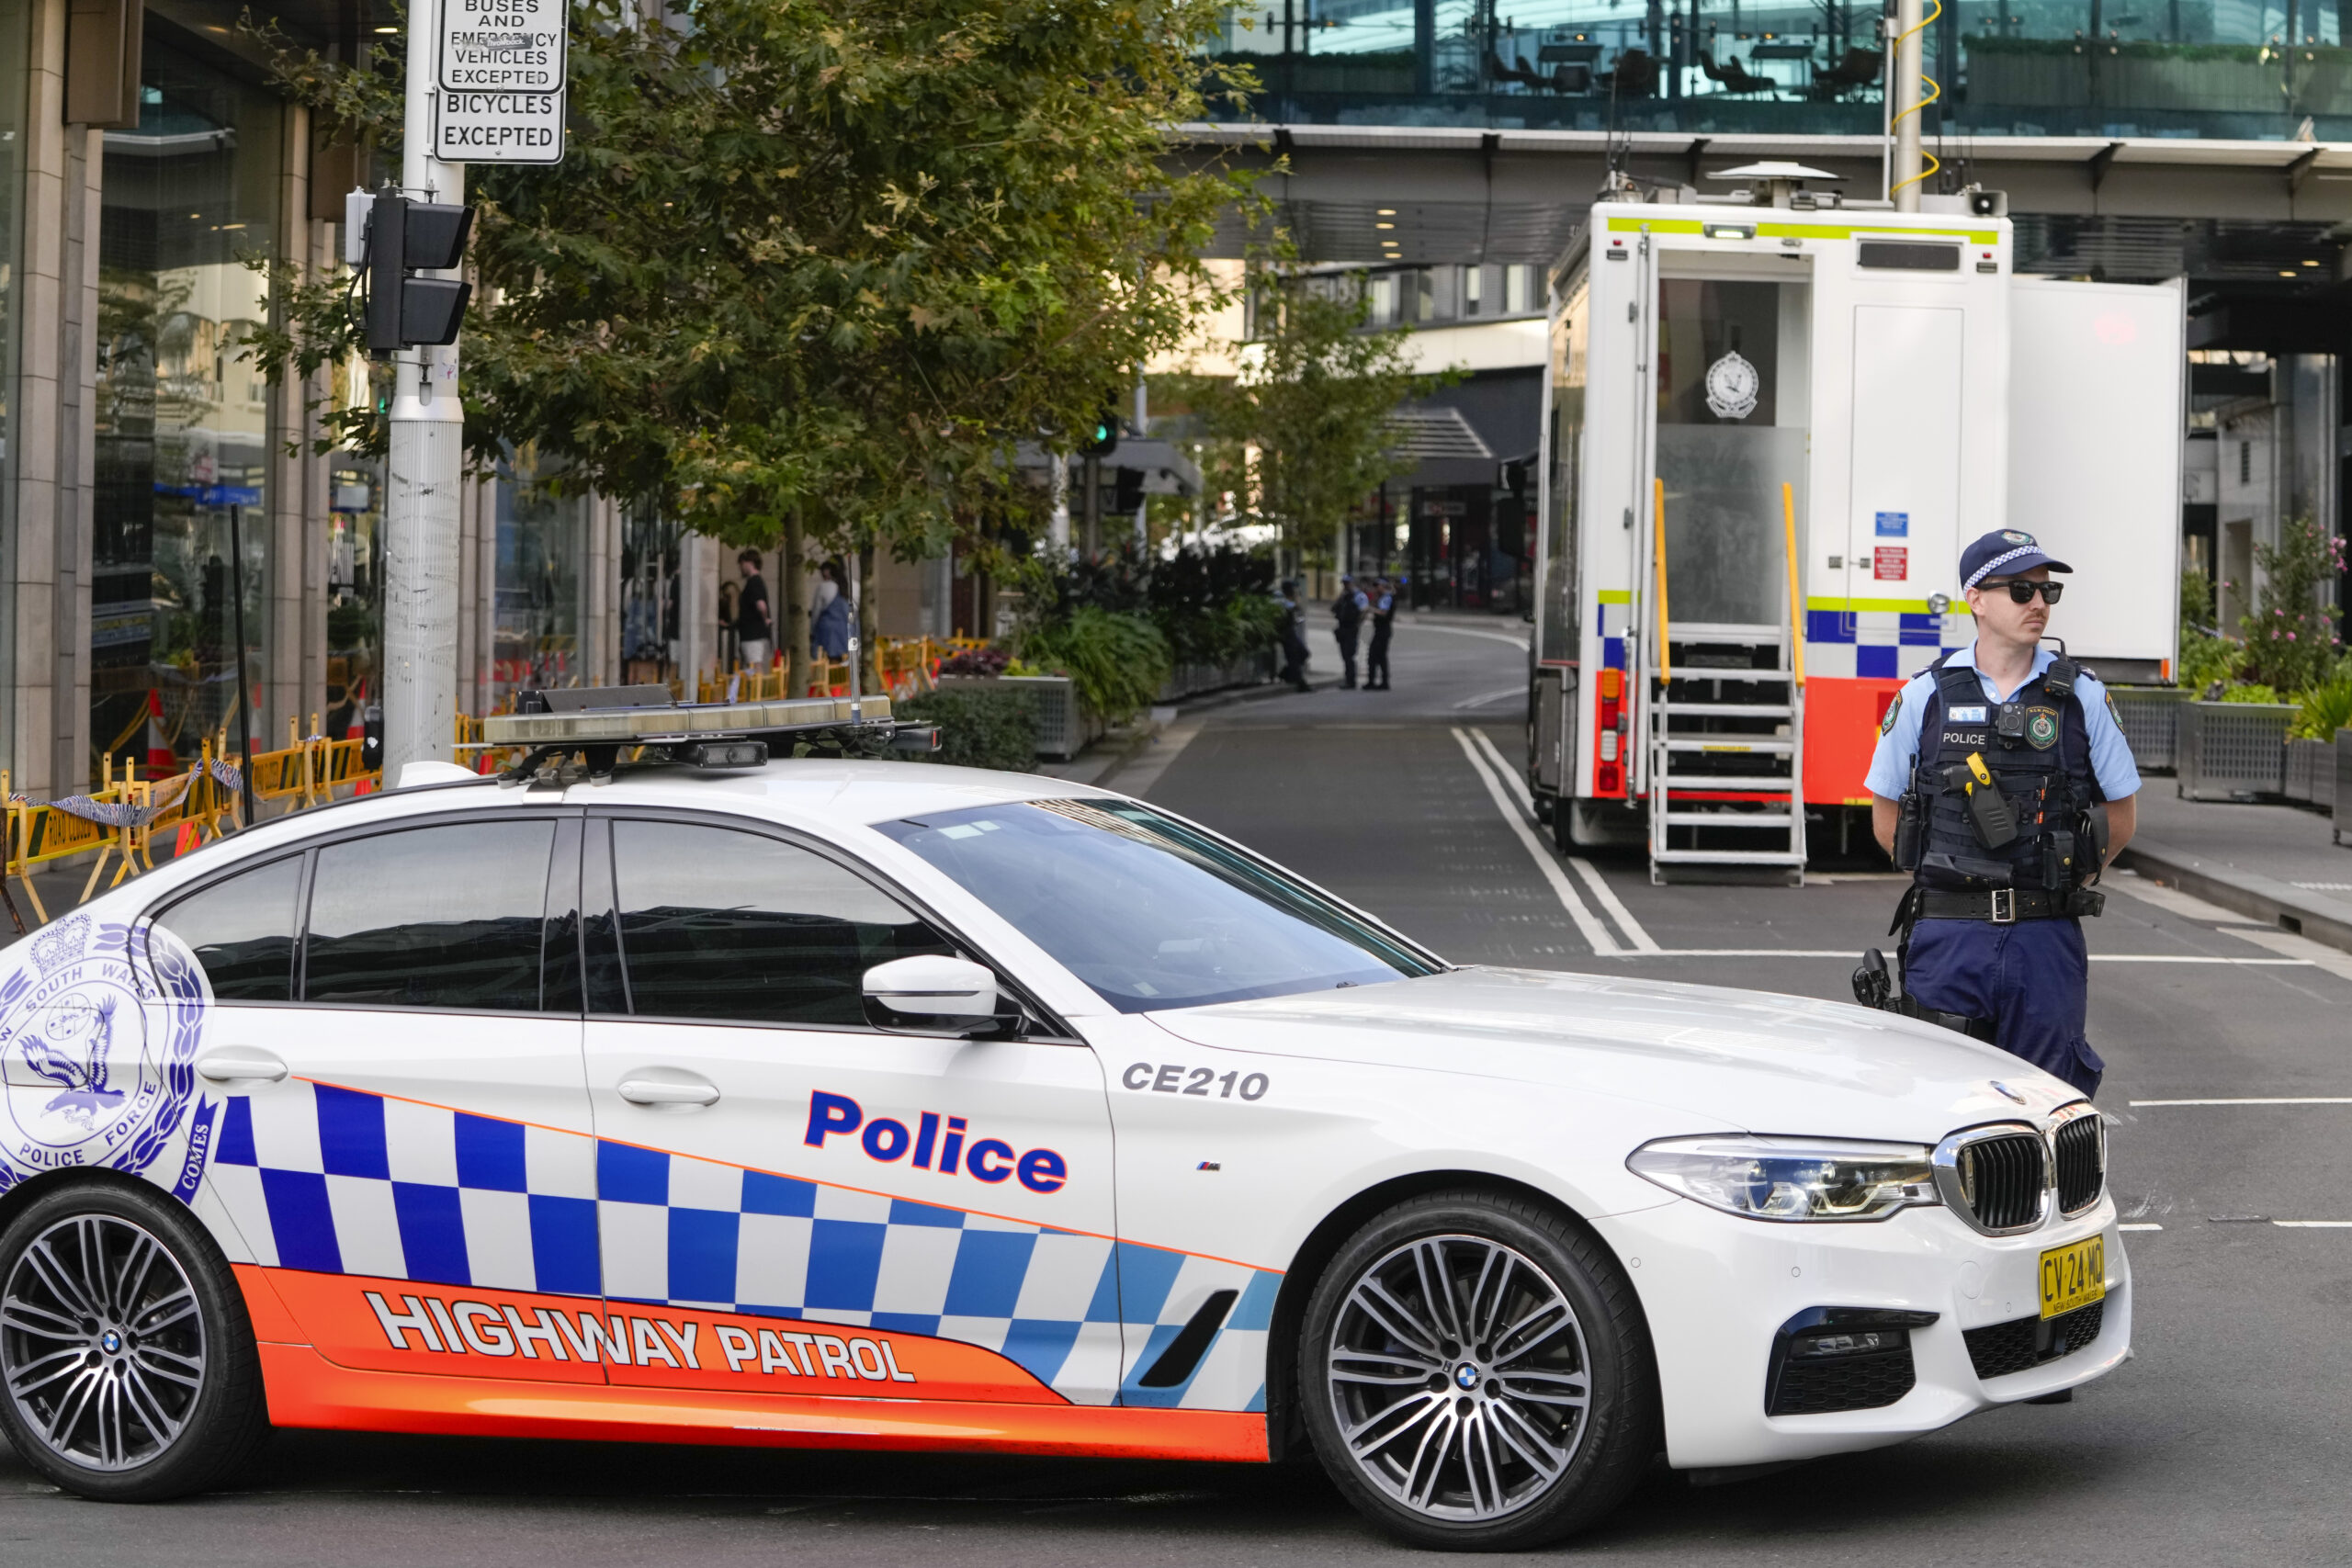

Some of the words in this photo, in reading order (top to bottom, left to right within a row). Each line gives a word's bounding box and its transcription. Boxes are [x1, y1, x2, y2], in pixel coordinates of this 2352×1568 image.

[465, 0, 539, 13] BUSES
[478, 15, 526, 28] AND
[451, 31, 557, 47] EMECY
[456, 50, 548, 65] VEHICLES
[452, 70, 549, 85] EXCEPTED
[447, 95, 552, 115] BICYCLES
[445, 126, 553, 146] EXCEPTED
[1943, 732, 1986, 745] POLICE
[49, 814, 67, 846] ROAD
[26, 966, 83, 1012] SOUTH
[102, 963, 156, 1000] WALES
[1122, 1062, 1270, 1101] CE210
[19, 1142, 85, 1168] POLICE
[105, 1081, 157, 1146] FORCE
[803, 1089, 1069, 1195] Police
[182, 1123, 210, 1190] COMES
[363, 1291, 703, 1371] HIGHWAY
[713, 1324, 918, 1383] PATROL
